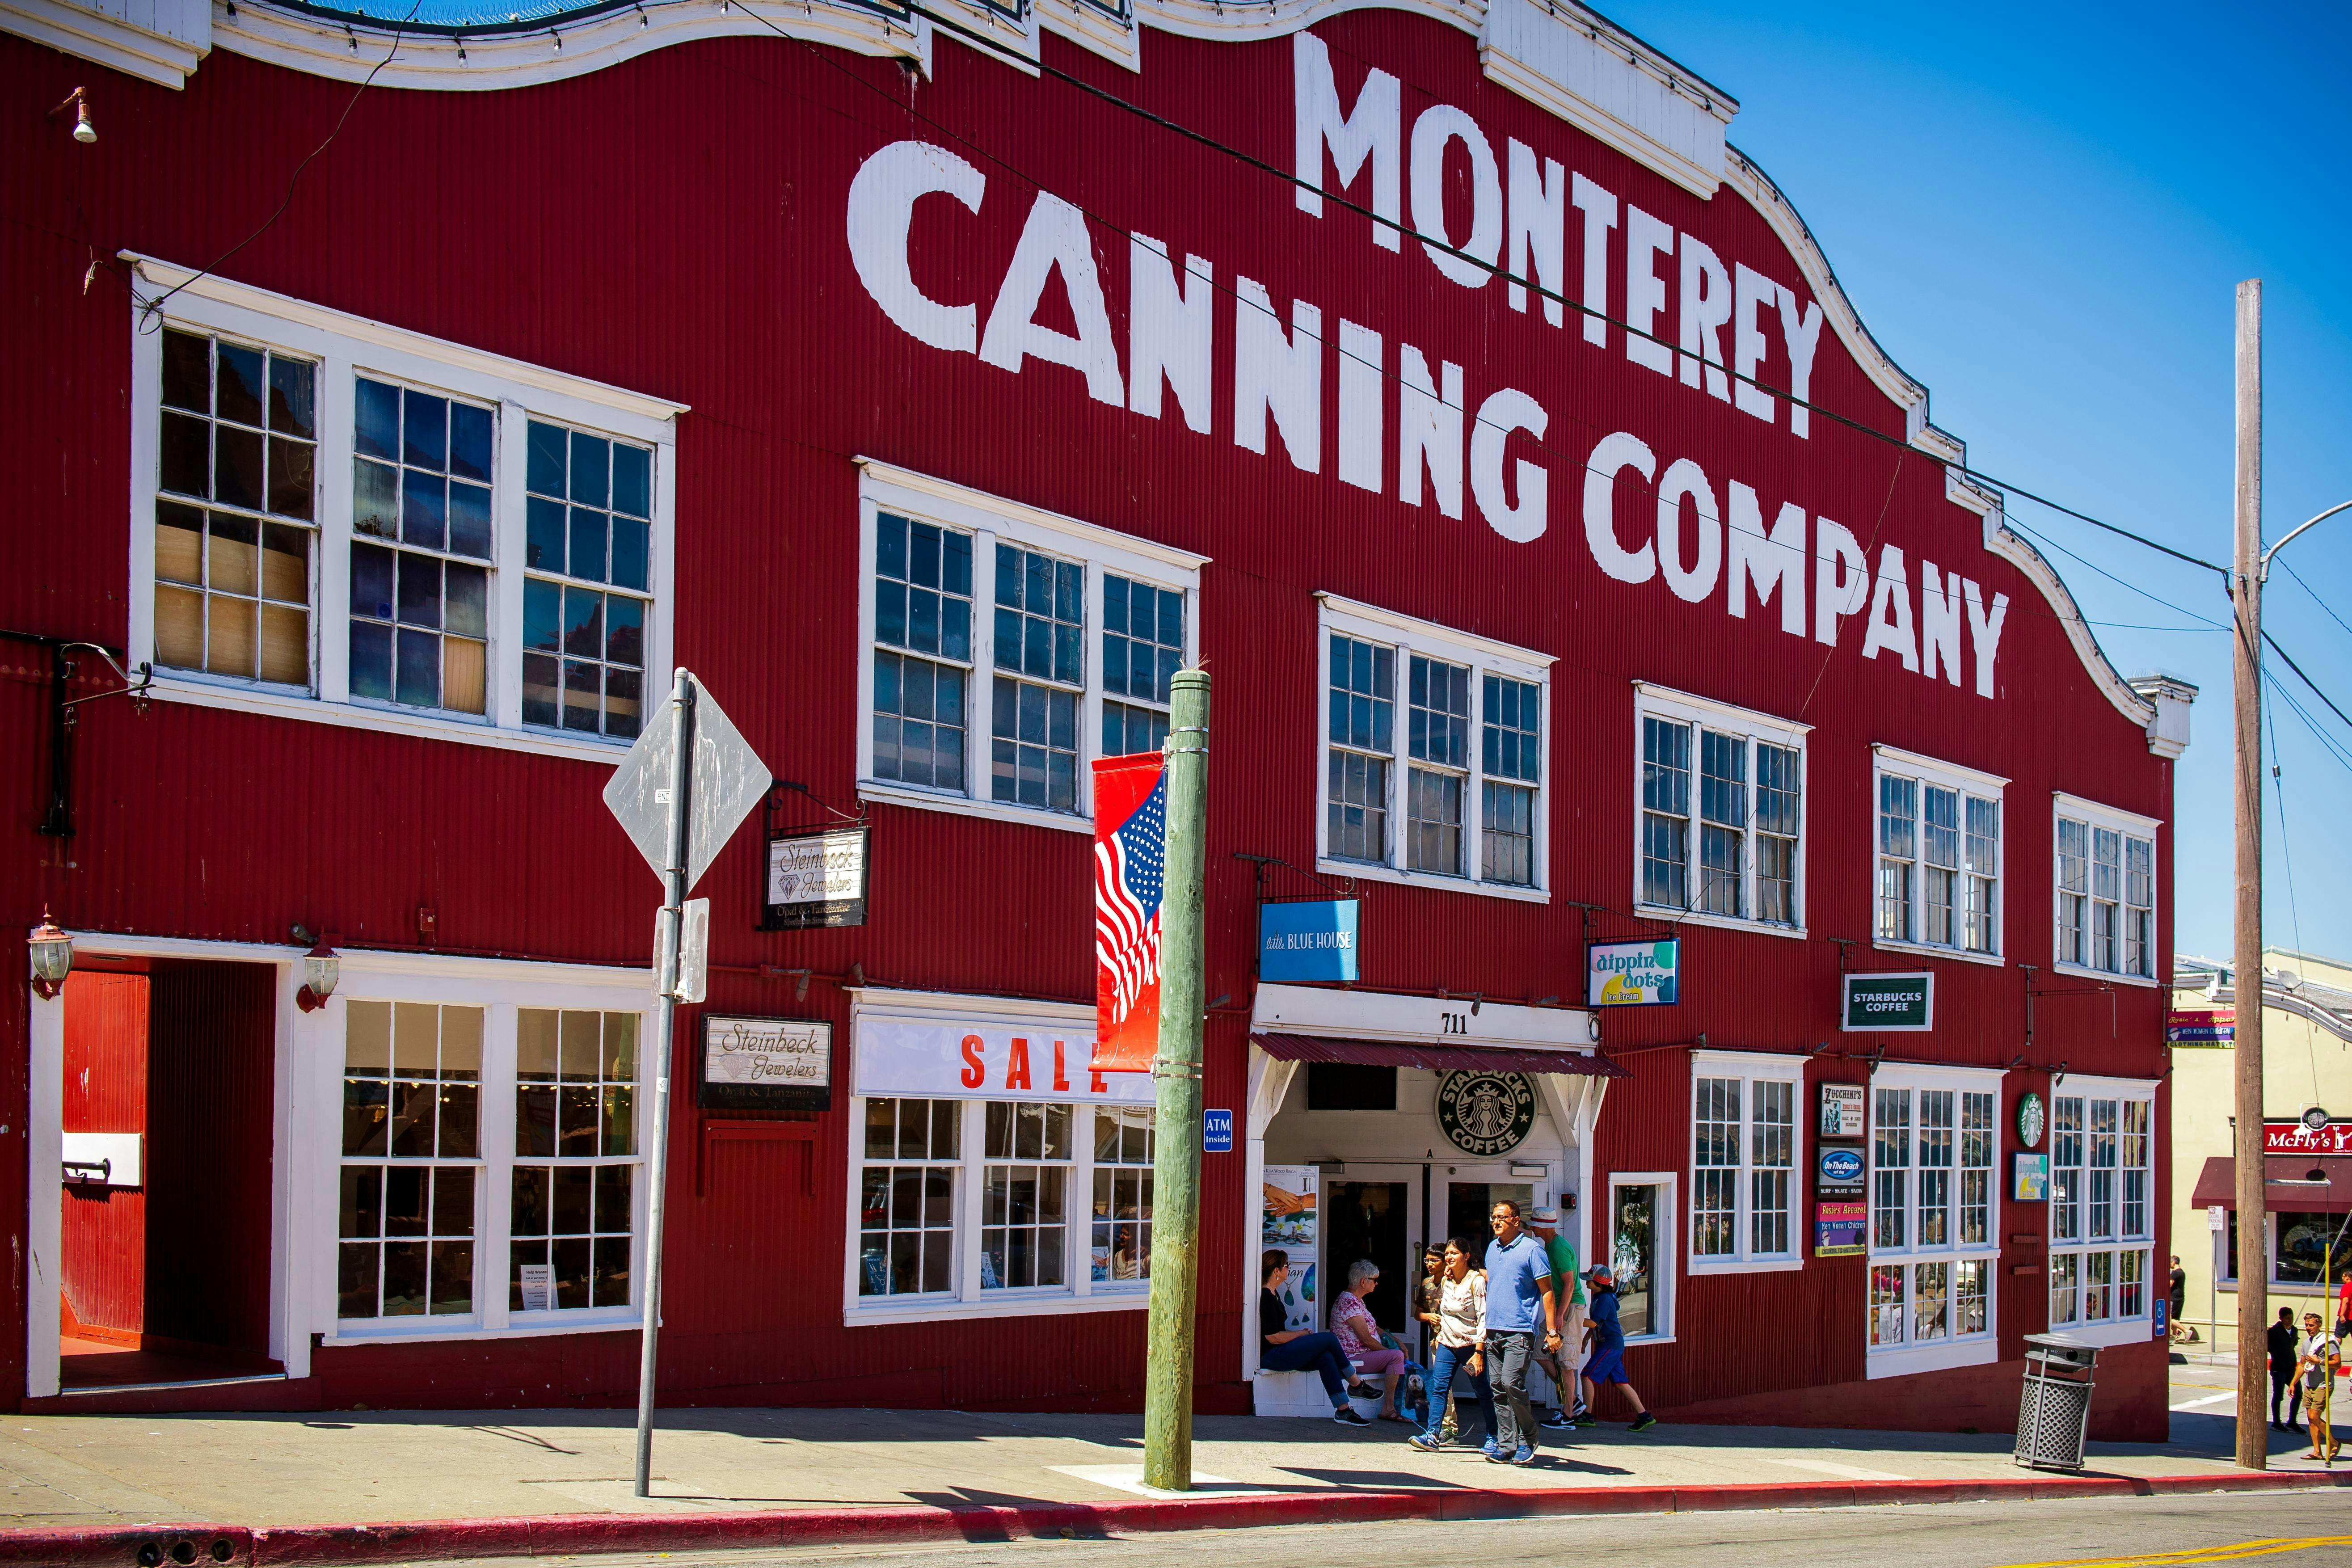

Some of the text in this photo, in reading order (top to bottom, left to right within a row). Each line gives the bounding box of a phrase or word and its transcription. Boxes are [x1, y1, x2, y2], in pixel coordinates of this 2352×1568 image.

[1294, 31, 1823, 439] MONTEREY
[847, 140, 2009, 699] CANNING COMPANY
[780, 839, 854, 873] Steinbeck
[801, 871, 852, 899] Jewelers
[1265, 931, 1352, 950] little BLUE HOUSE
[1597, 952, 1660, 973] dippin'
[1623, 972, 1665, 988] dots
[1606, 992, 1639, 1001] Ice Cream
[1853, 992, 1922, 1003] STARBUCKS
[1866, 1003, 1909, 1012] COFFEE
[1441, 1012, 1467, 1034] 711
[2207, 1016, 2235, 1024] Appar
[722, 1024, 818, 1054] Steinbeck
[751, 1055, 817, 1080] Jewelers
[749, 1087, 761, 1097] &
[1825, 1088, 1862, 1104] ZUCCHINI'S
[1206, 1119, 1230, 1131] ATM
[1206, 1134, 1230, 1144] Inside
[1452, 1128, 1519, 1154] COFFEE
[2267, 1133, 2331, 1150] McFly's
[1427, 1148, 1433, 1158] A
[1825, 1161, 1859, 1170] On The Beach
[1822, 1205, 1866, 1214] Rosie's Apparel
[1821, 1222, 1830, 1230] Men
[1848, 1221, 1865, 1229] Children
